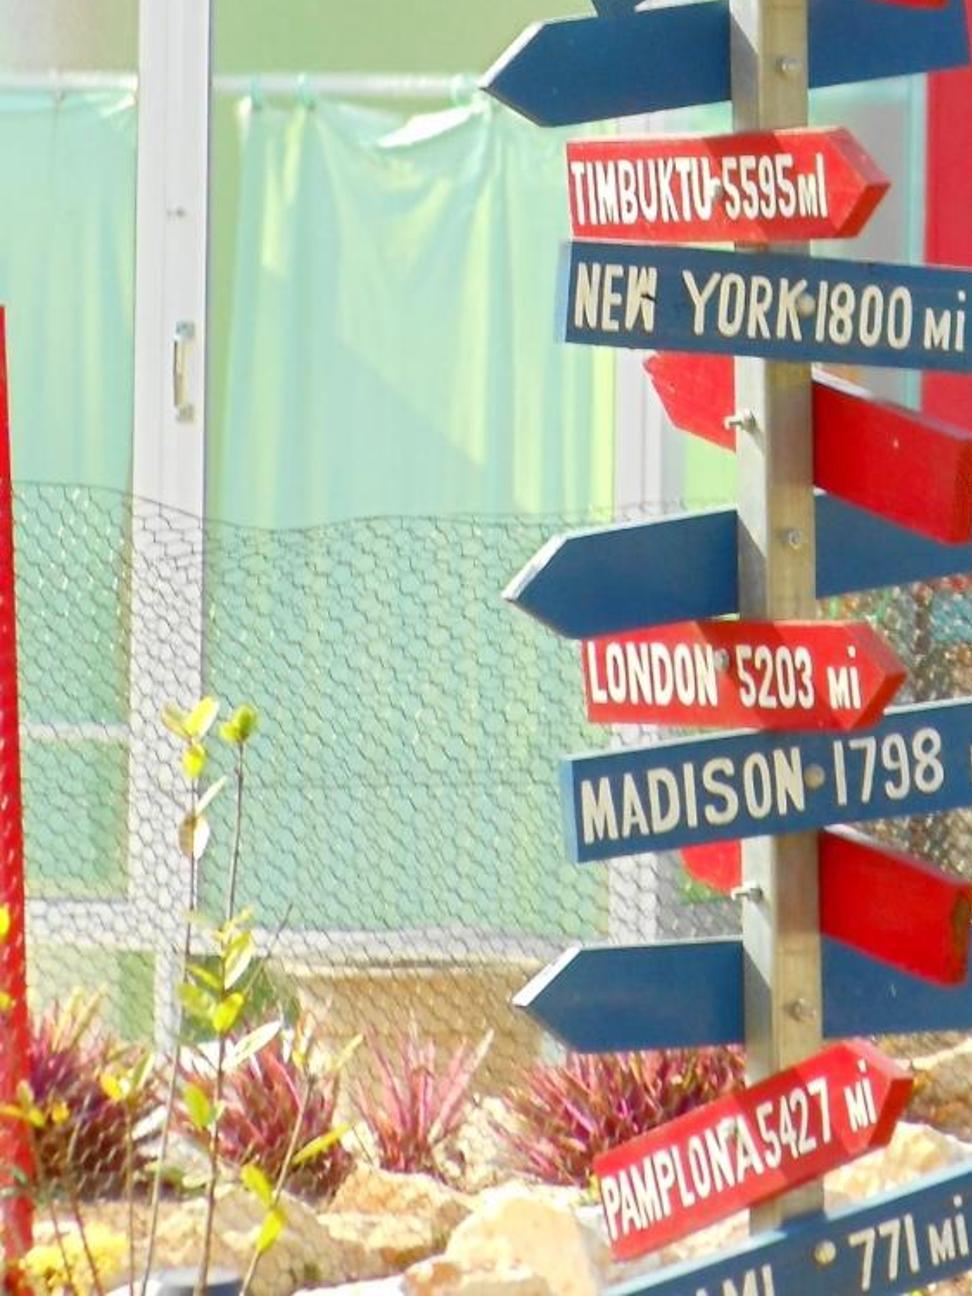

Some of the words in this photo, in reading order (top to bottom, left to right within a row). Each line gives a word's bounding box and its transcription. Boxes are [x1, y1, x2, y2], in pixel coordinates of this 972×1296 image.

[571, 153, 712, 225] TIMBUKTU
[722, 153, 796, 220] 5595
[574, 262, 657, 332] NEW
[683, 268, 807, 341] YORK
[815, 280, 912, 349] 1800
[587, 640, 718, 707] LONDON
[736, 643, 815, 709] 5203
[580, 746, 806, 845] MADISON
[833, 727, 945, 806] 1798
[601, 1115, 764, 1243] PAMPLONA
[756, 1076, 831, 1167] 5427
[848, 1213, 920, 1291] 771
